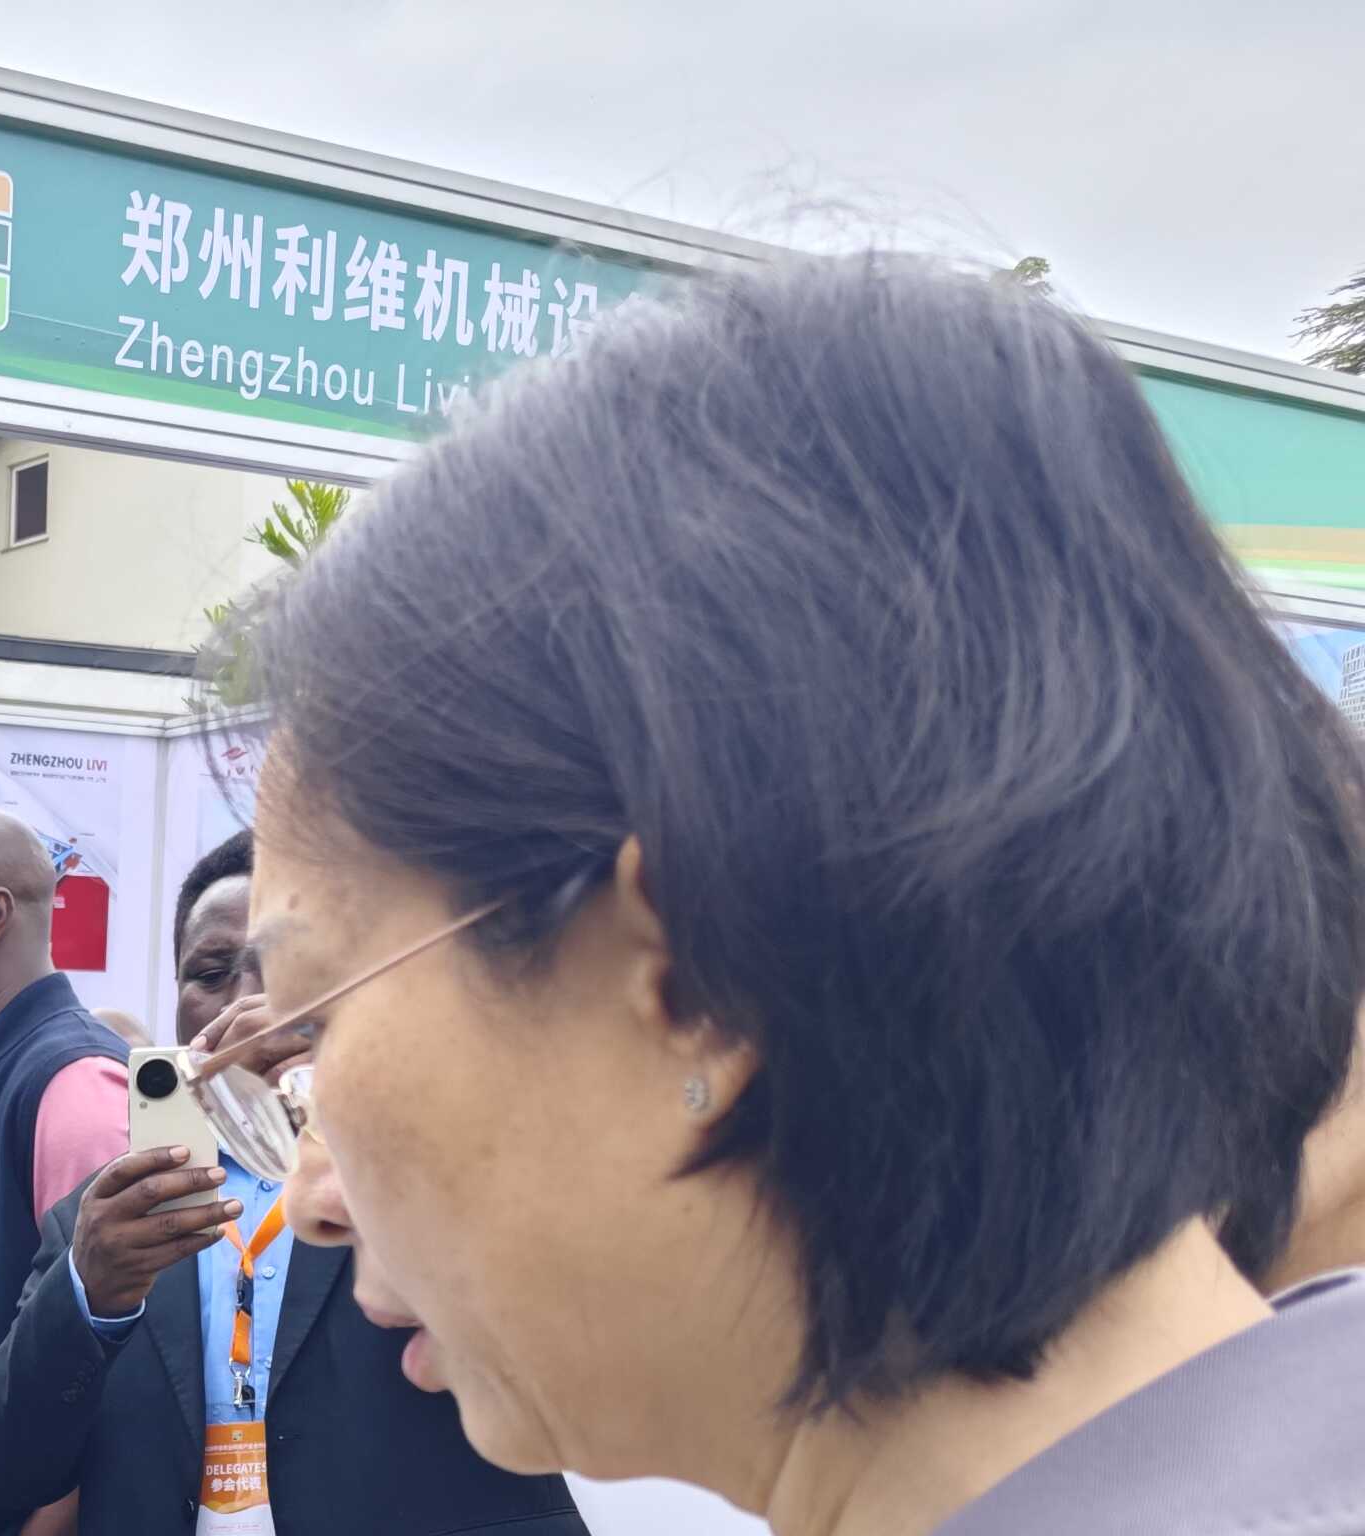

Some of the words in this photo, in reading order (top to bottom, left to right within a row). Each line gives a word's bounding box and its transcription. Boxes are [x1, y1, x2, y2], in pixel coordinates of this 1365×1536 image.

[120, 189, 609, 358] 郑州利维机械设
[116, 316, 375, 407] Zhengzhou
[10, 752, 84, 771] ZHENGZHOU
[85, 758, 108, 772] LIVI
[205, 1462, 267, 1476] DELEGATES
